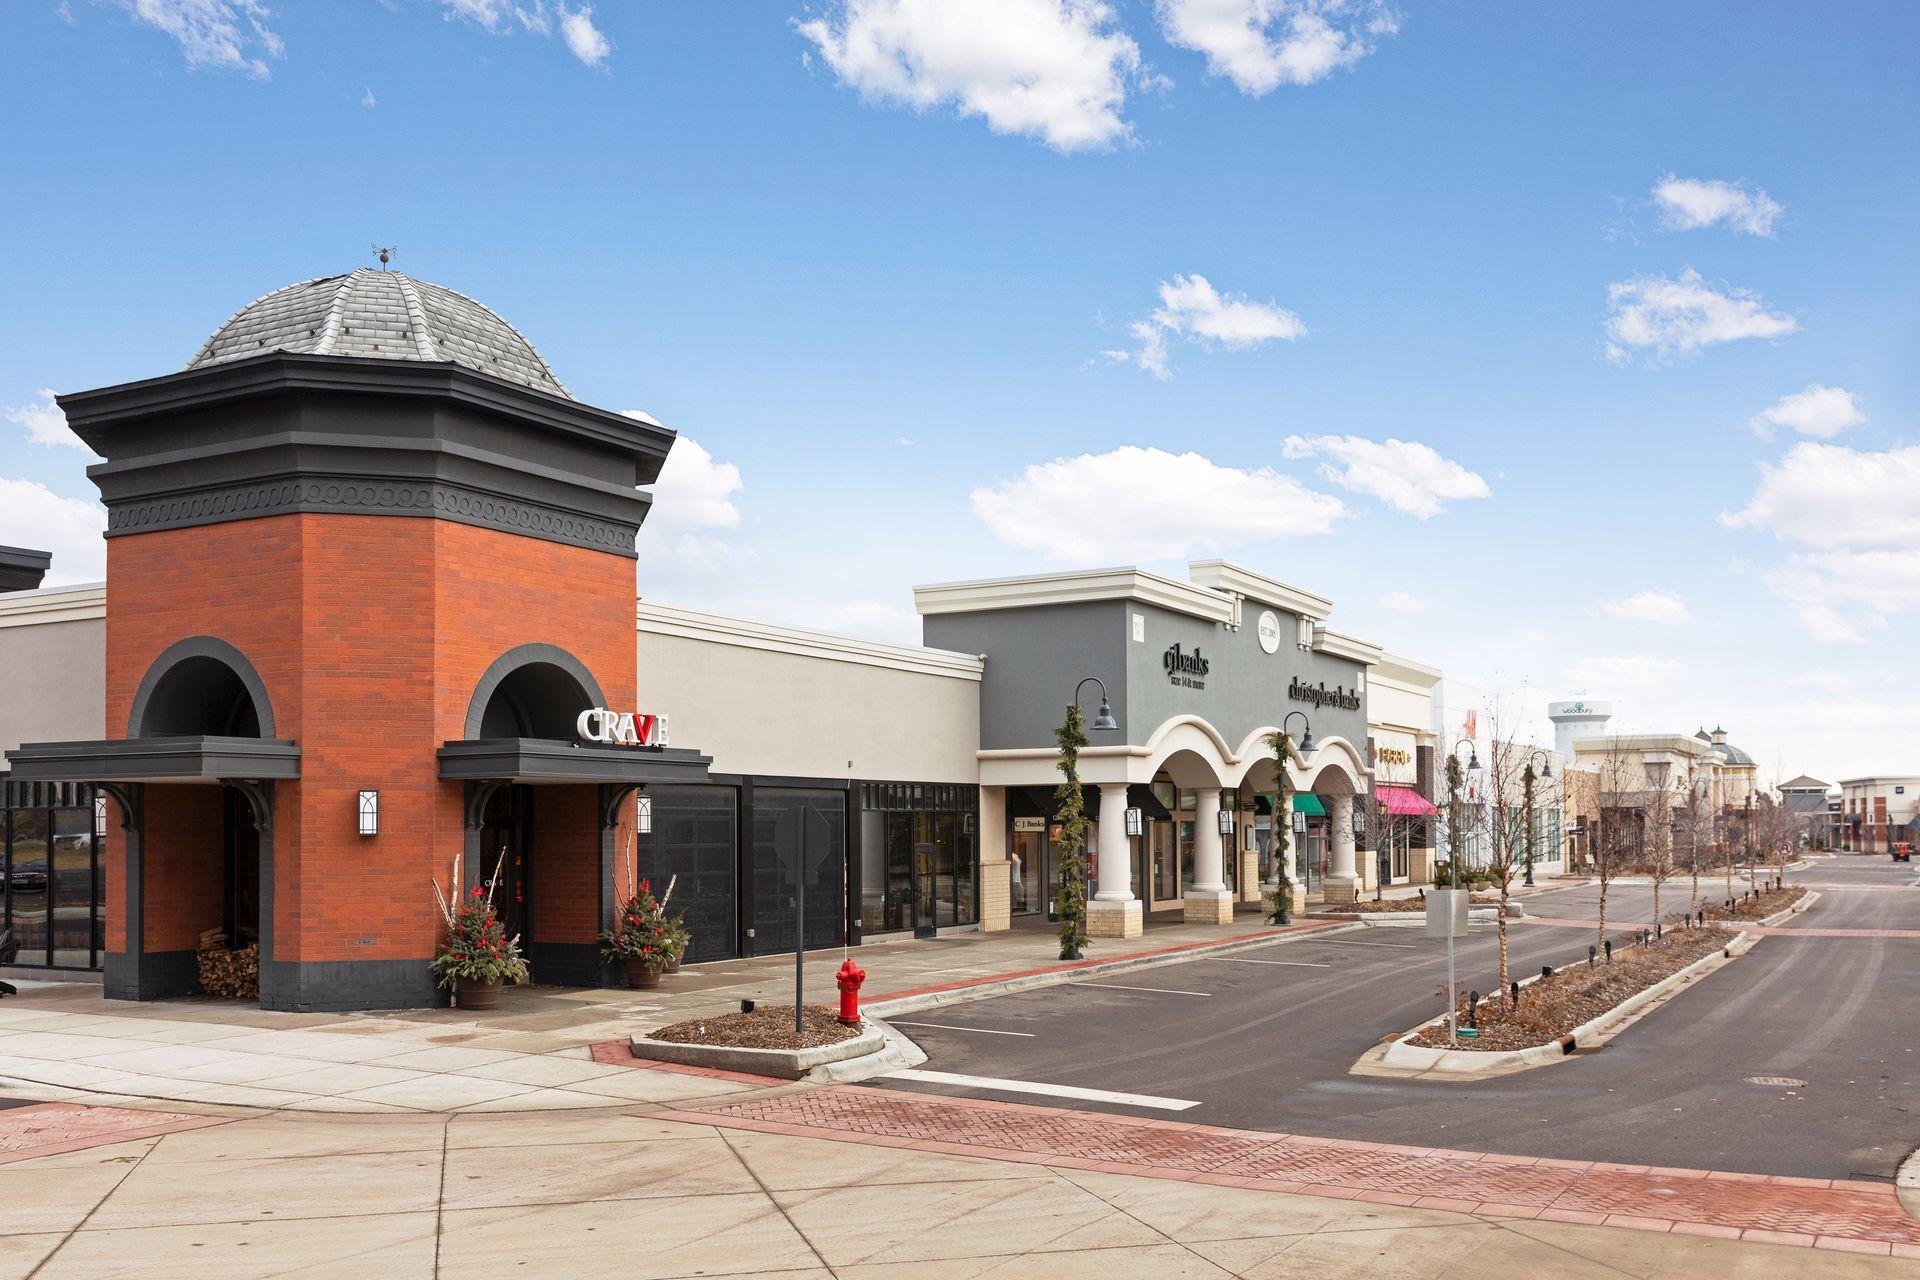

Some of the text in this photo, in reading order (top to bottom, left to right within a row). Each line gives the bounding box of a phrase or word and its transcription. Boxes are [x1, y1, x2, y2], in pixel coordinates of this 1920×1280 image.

[577, 707, 668, 747] CRAVE
[1027, 820, 1045, 828] Banks
[484, 879, 503, 887] CRE
